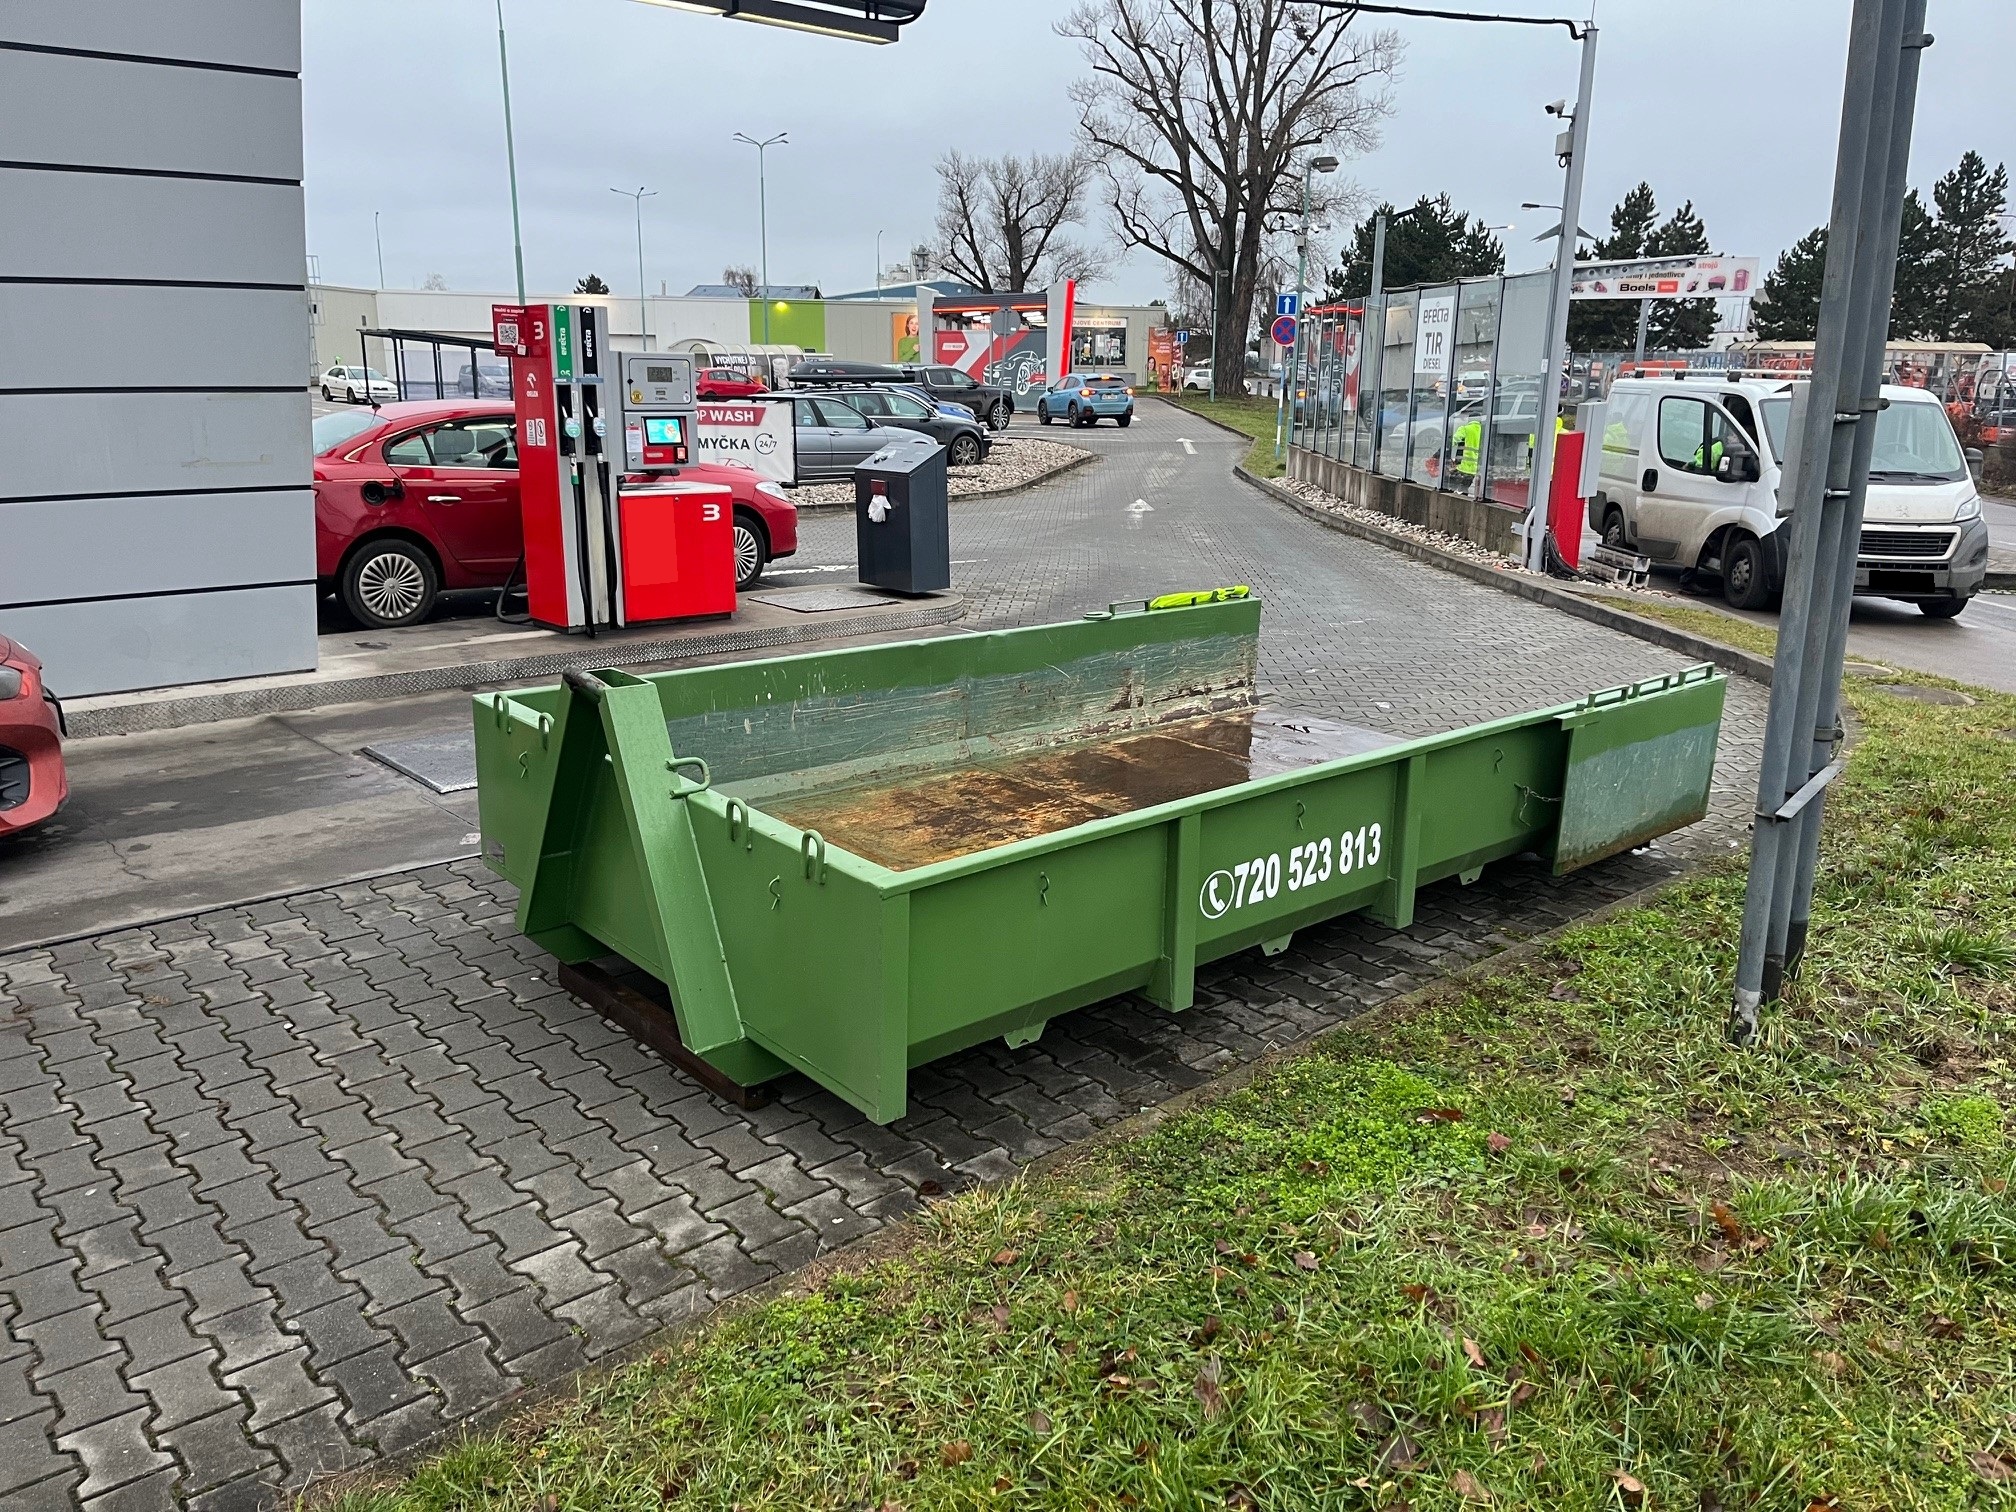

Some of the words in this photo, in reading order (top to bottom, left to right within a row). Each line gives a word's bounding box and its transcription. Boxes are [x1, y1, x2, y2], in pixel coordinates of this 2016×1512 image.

[1648, 271, 1685, 280] jednotlivce
[1620, 283, 1656, 291] Boels
[533, 321, 544, 340] 3
[1425, 332, 1443, 355] TIR
[1423, 358, 1441, 369] DIESEL
[709, 410, 755, 423] WASH
[698, 434, 750, 450] MYČKA
[759, 440, 777, 448] 24/7
[702, 503, 720, 522] 3
[1234, 853, 1281, 909] 720
[1287, 837, 1332, 892] 523
[1339, 822, 1382, 875] 813
